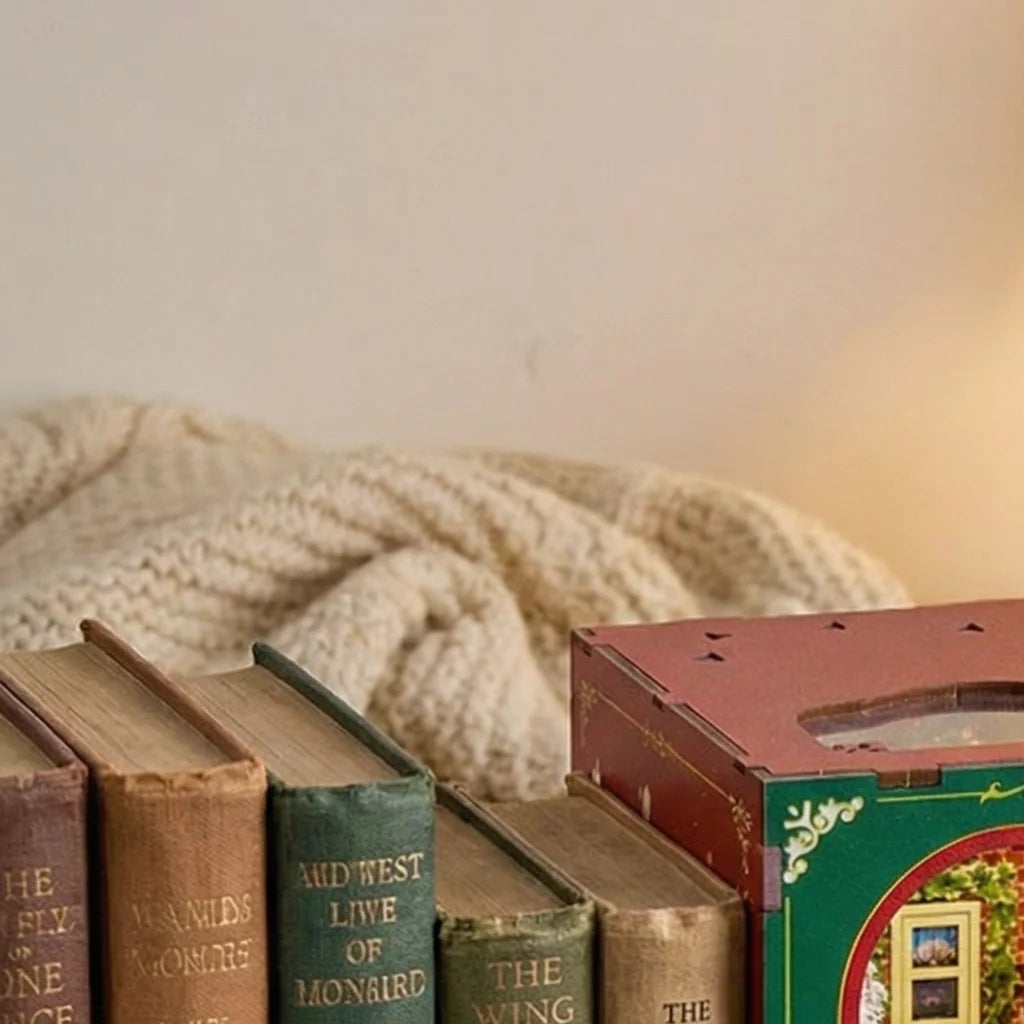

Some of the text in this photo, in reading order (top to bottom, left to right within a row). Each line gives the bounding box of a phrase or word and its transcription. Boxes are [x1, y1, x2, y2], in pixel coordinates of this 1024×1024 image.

[345, 938, 383, 965] OF
[488, 957, 563, 990] THE
[663, 999, 711, 1024] THE
